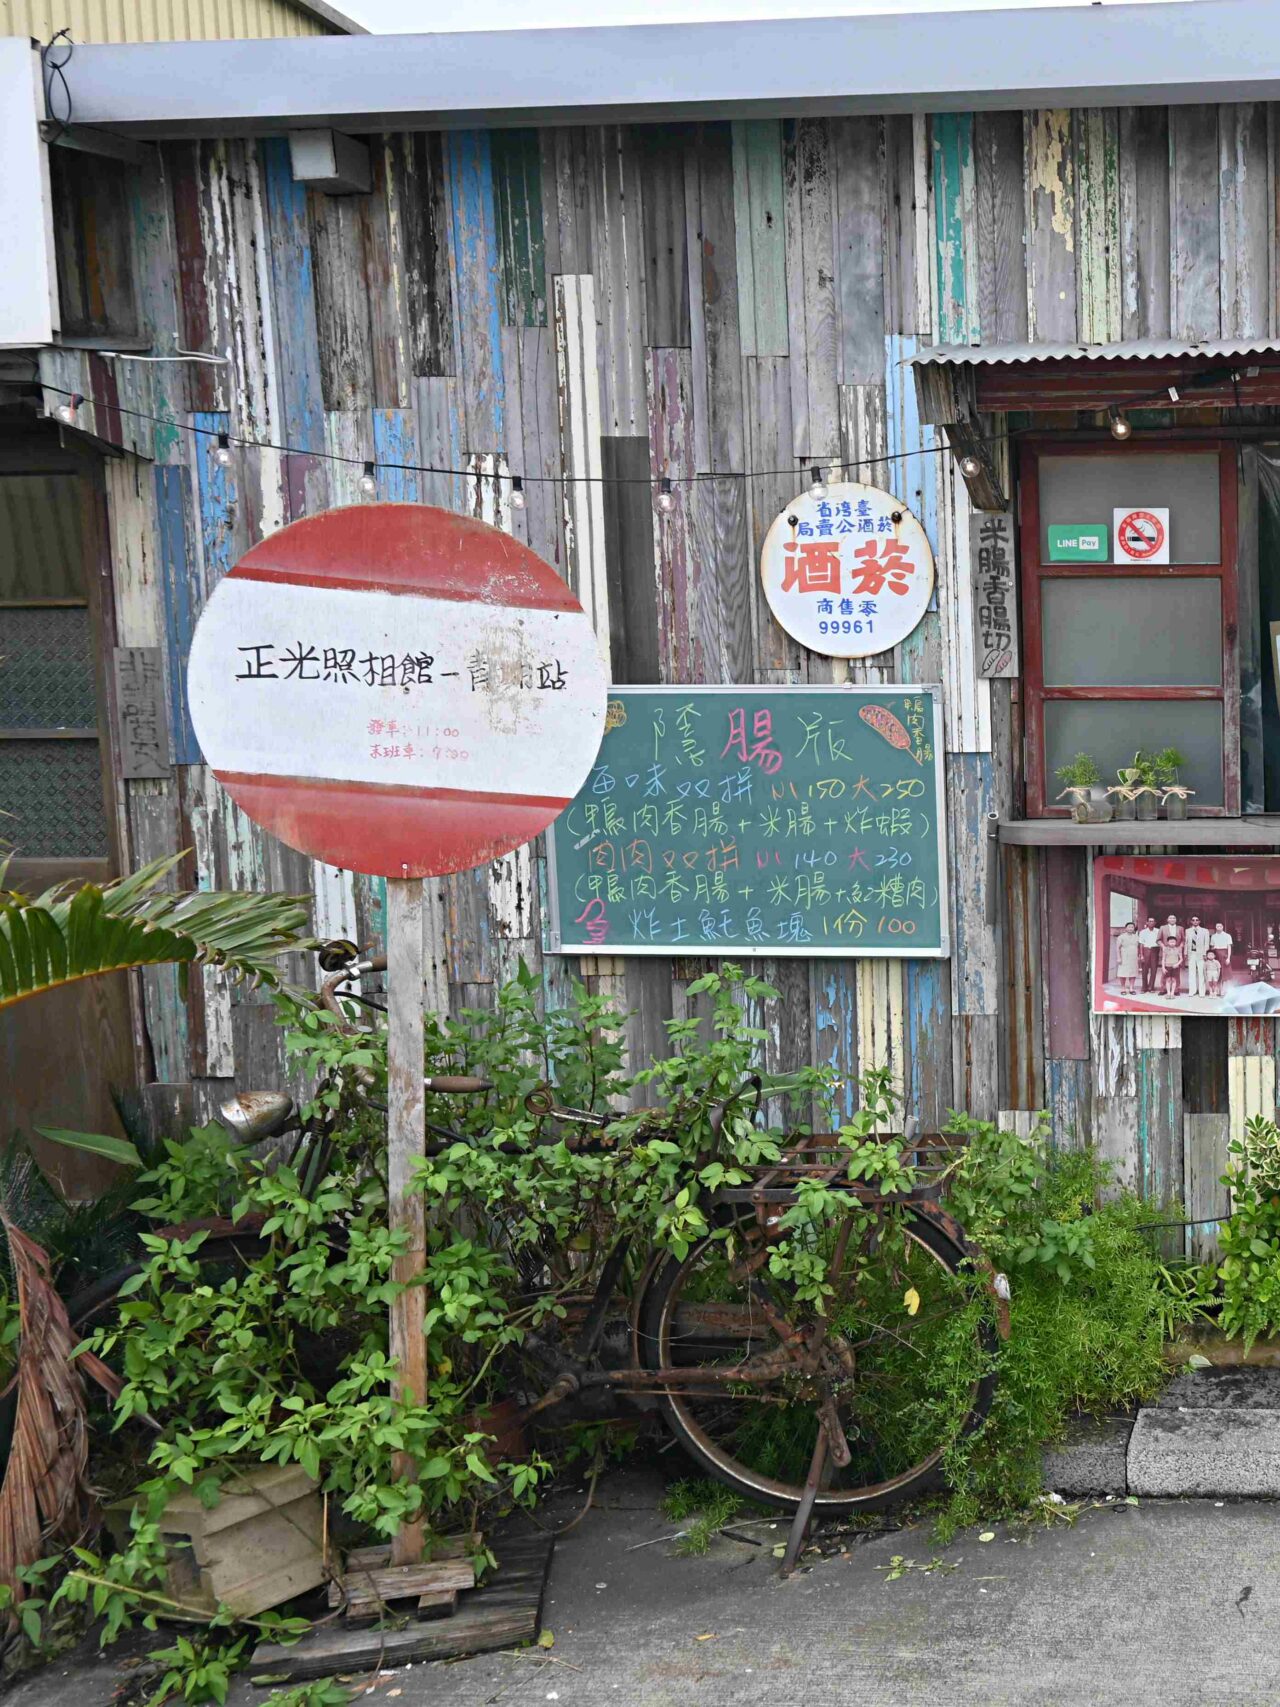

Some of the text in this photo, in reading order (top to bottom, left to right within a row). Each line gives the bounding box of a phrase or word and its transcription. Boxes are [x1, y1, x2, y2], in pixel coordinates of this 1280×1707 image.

[1057, 538, 1097, 549] LINE Pay
[978, 518, 1012, 651] 米腸香腸切
[819, 619, 875, 635] 99961
[878, 916, 916, 935] 100
